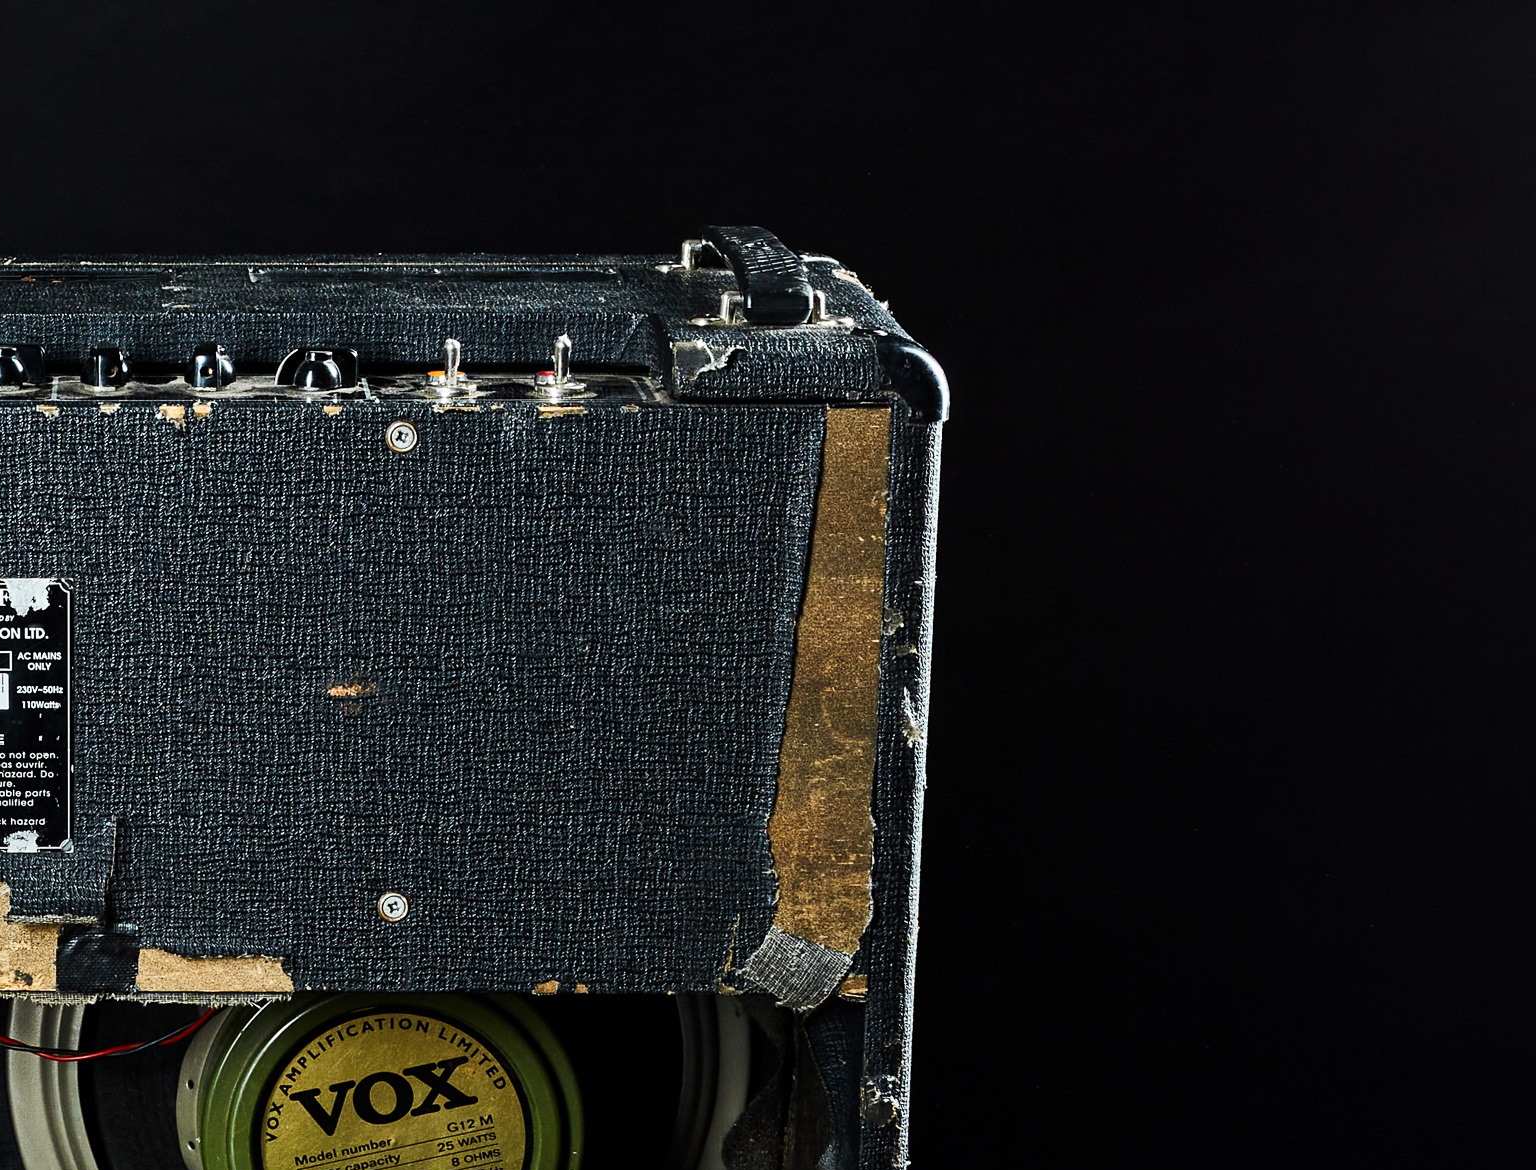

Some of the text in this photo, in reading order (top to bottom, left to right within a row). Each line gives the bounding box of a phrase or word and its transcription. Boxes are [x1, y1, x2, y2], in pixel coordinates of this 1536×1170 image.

[24, 627, 49, 640] LTD.
[17, 652, 62, 661] AC MAINS
[27, 662, 52, 671] ONLY
[22, 700, 59, 709] 110Watts
[30, 752, 59, 760] open.
[40, 770, 54, 778] Do
[266, 1017, 507, 1142] VOX AMPLIFICATION LIMITED
[289, 1055, 479, 1136] VOX
[294, 1114, 493, 1166] Model number G12 M
[437, 1141, 455, 1153] 25
[458, 1132, 497, 1148] WATTS
[451, 1157, 460, 1168] 8
[463, 1149, 501, 1164] OHMS
